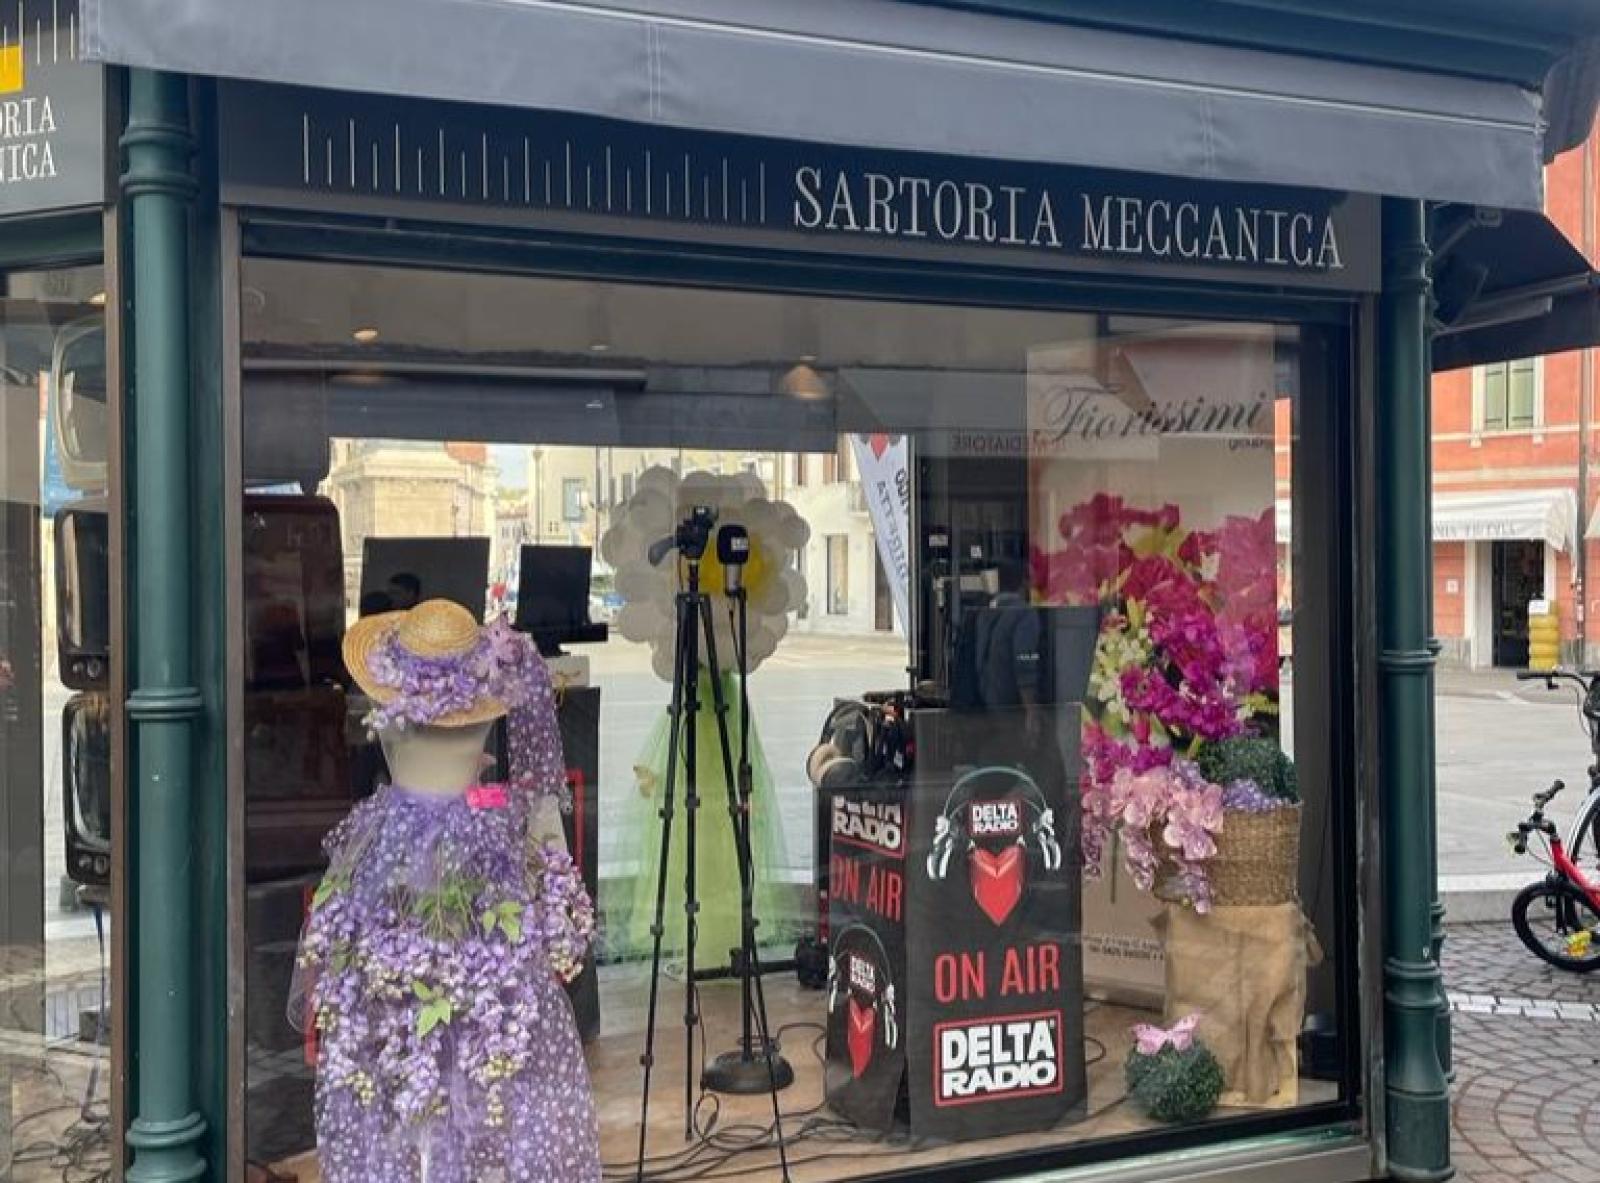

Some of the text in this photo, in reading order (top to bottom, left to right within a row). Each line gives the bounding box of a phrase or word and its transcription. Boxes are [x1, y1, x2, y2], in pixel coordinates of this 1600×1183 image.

[0, 95, 57, 137] RIA
[793, 166, 1344, 269] SARTORIA MECCANICA
[832, 809, 901, 849] RADIO
[972, 803, 1018, 821] DELTA
[831, 853, 903, 922] ON AIR
[934, 944, 1060, 1003] ON AIR
[941, 1020, 1056, 1070] DELTA
[942, 1060, 1057, 1098] RADIO
